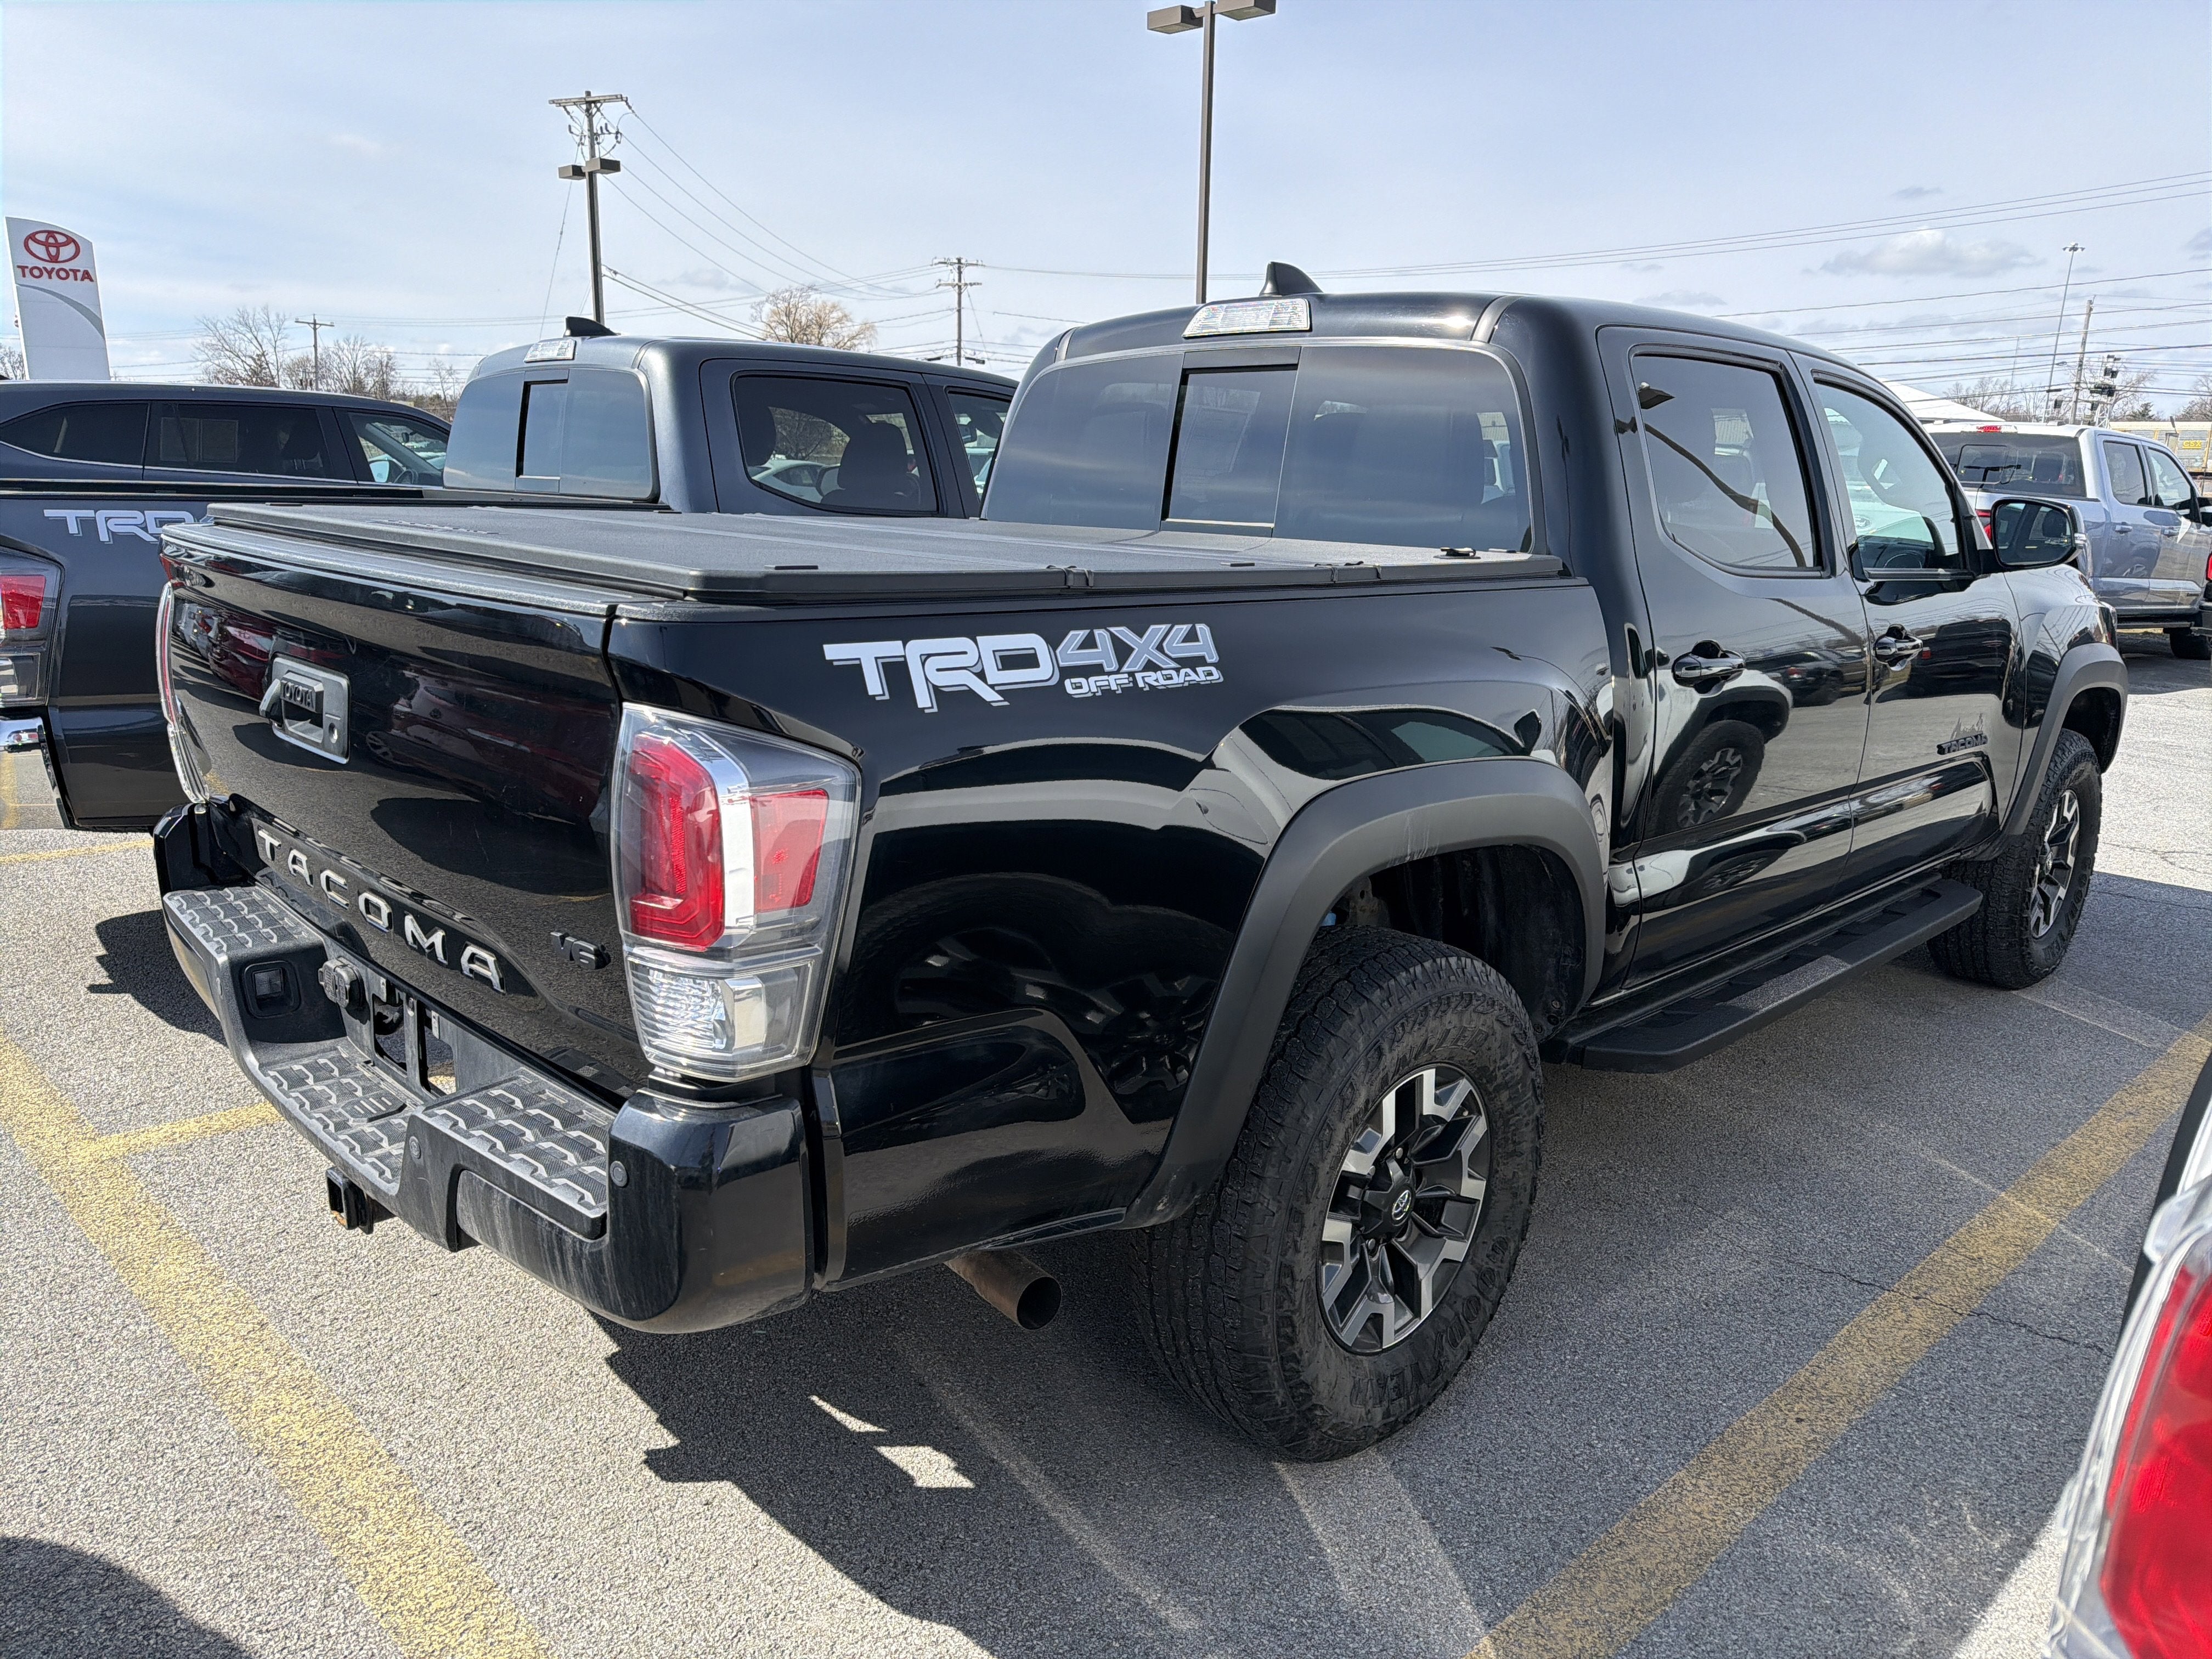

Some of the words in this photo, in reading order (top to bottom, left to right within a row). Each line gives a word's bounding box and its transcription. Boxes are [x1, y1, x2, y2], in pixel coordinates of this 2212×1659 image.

[16, 265, 94, 283] TOYOTA
[43, 509, 196, 544] TRD
[822, 633, 1060, 713] TRD
[1056, 623, 1220, 673] 4X4
[1064, 673, 1133, 698] OFF
[1134, 665, 1224, 691] ROAD
[280, 680, 315, 709] TOYOTA
[1942, 734, 1988, 754] TACOMA
[257, 826, 506, 995] TACOMA
[550, 931, 597, 970] V6
[1349, 1235, 1509, 1409] GOODYEAR
